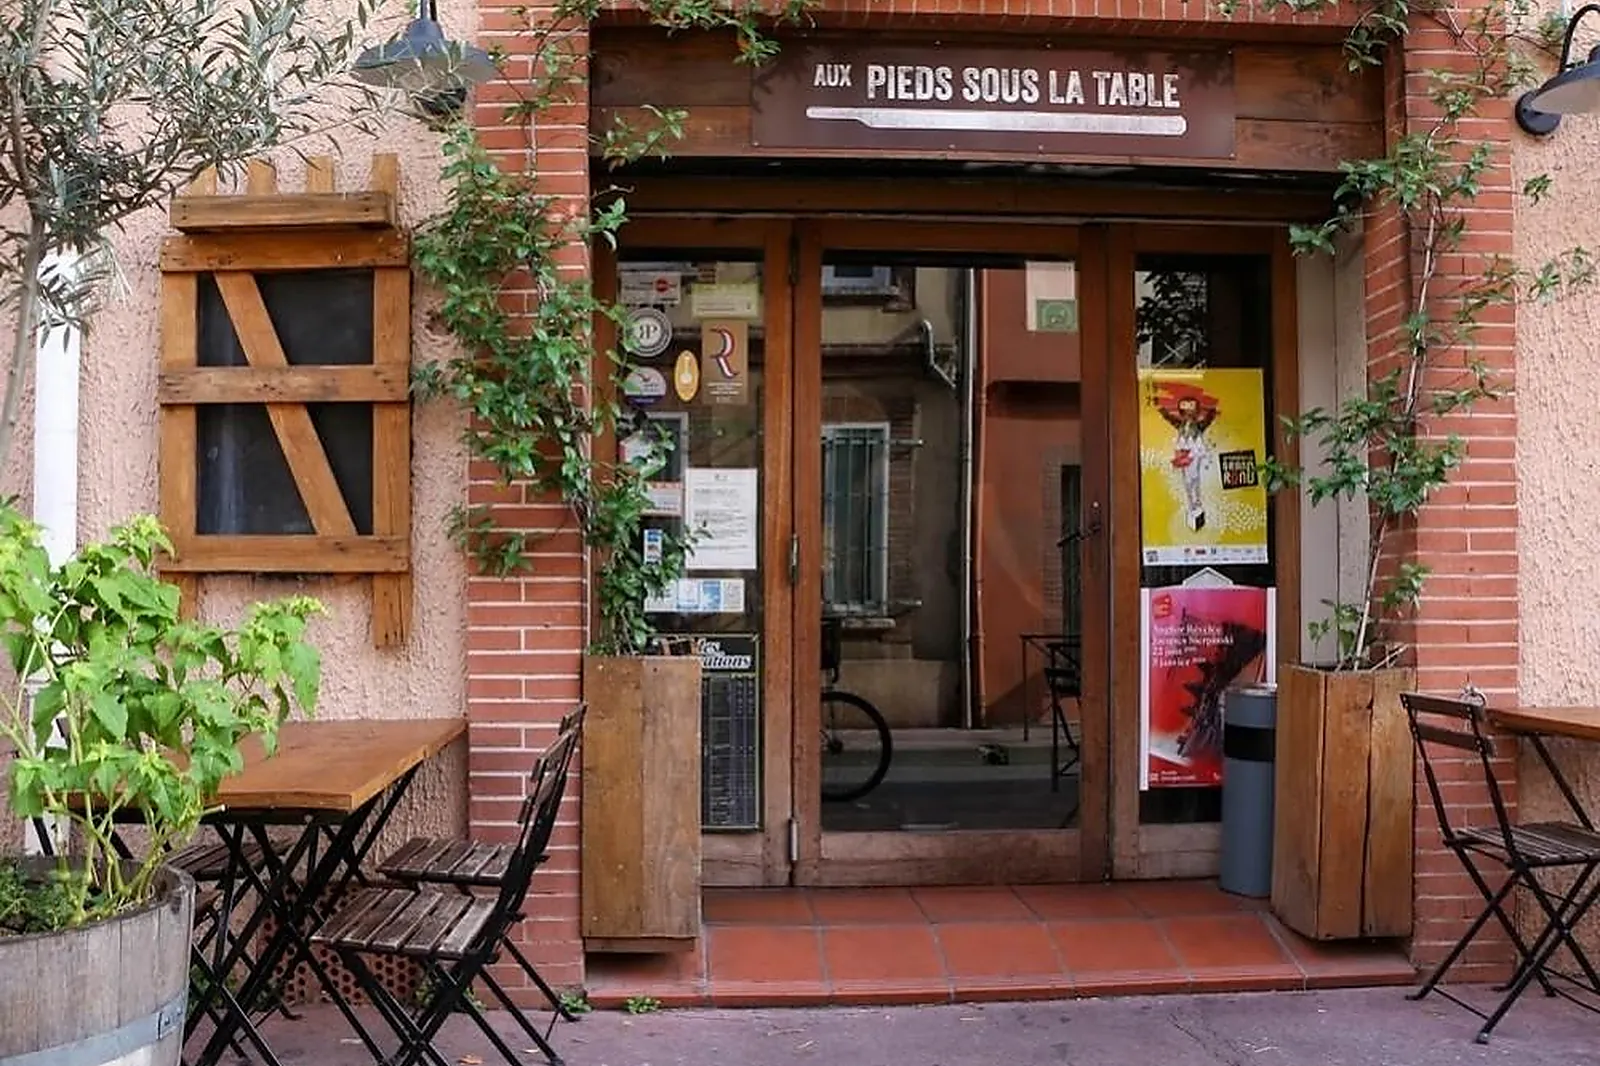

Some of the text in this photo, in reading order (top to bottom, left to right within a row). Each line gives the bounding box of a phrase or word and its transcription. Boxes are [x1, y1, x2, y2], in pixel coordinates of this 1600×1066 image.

[813, 64, 1181, 108] AUX PIEDS SOUS LA TABLE
